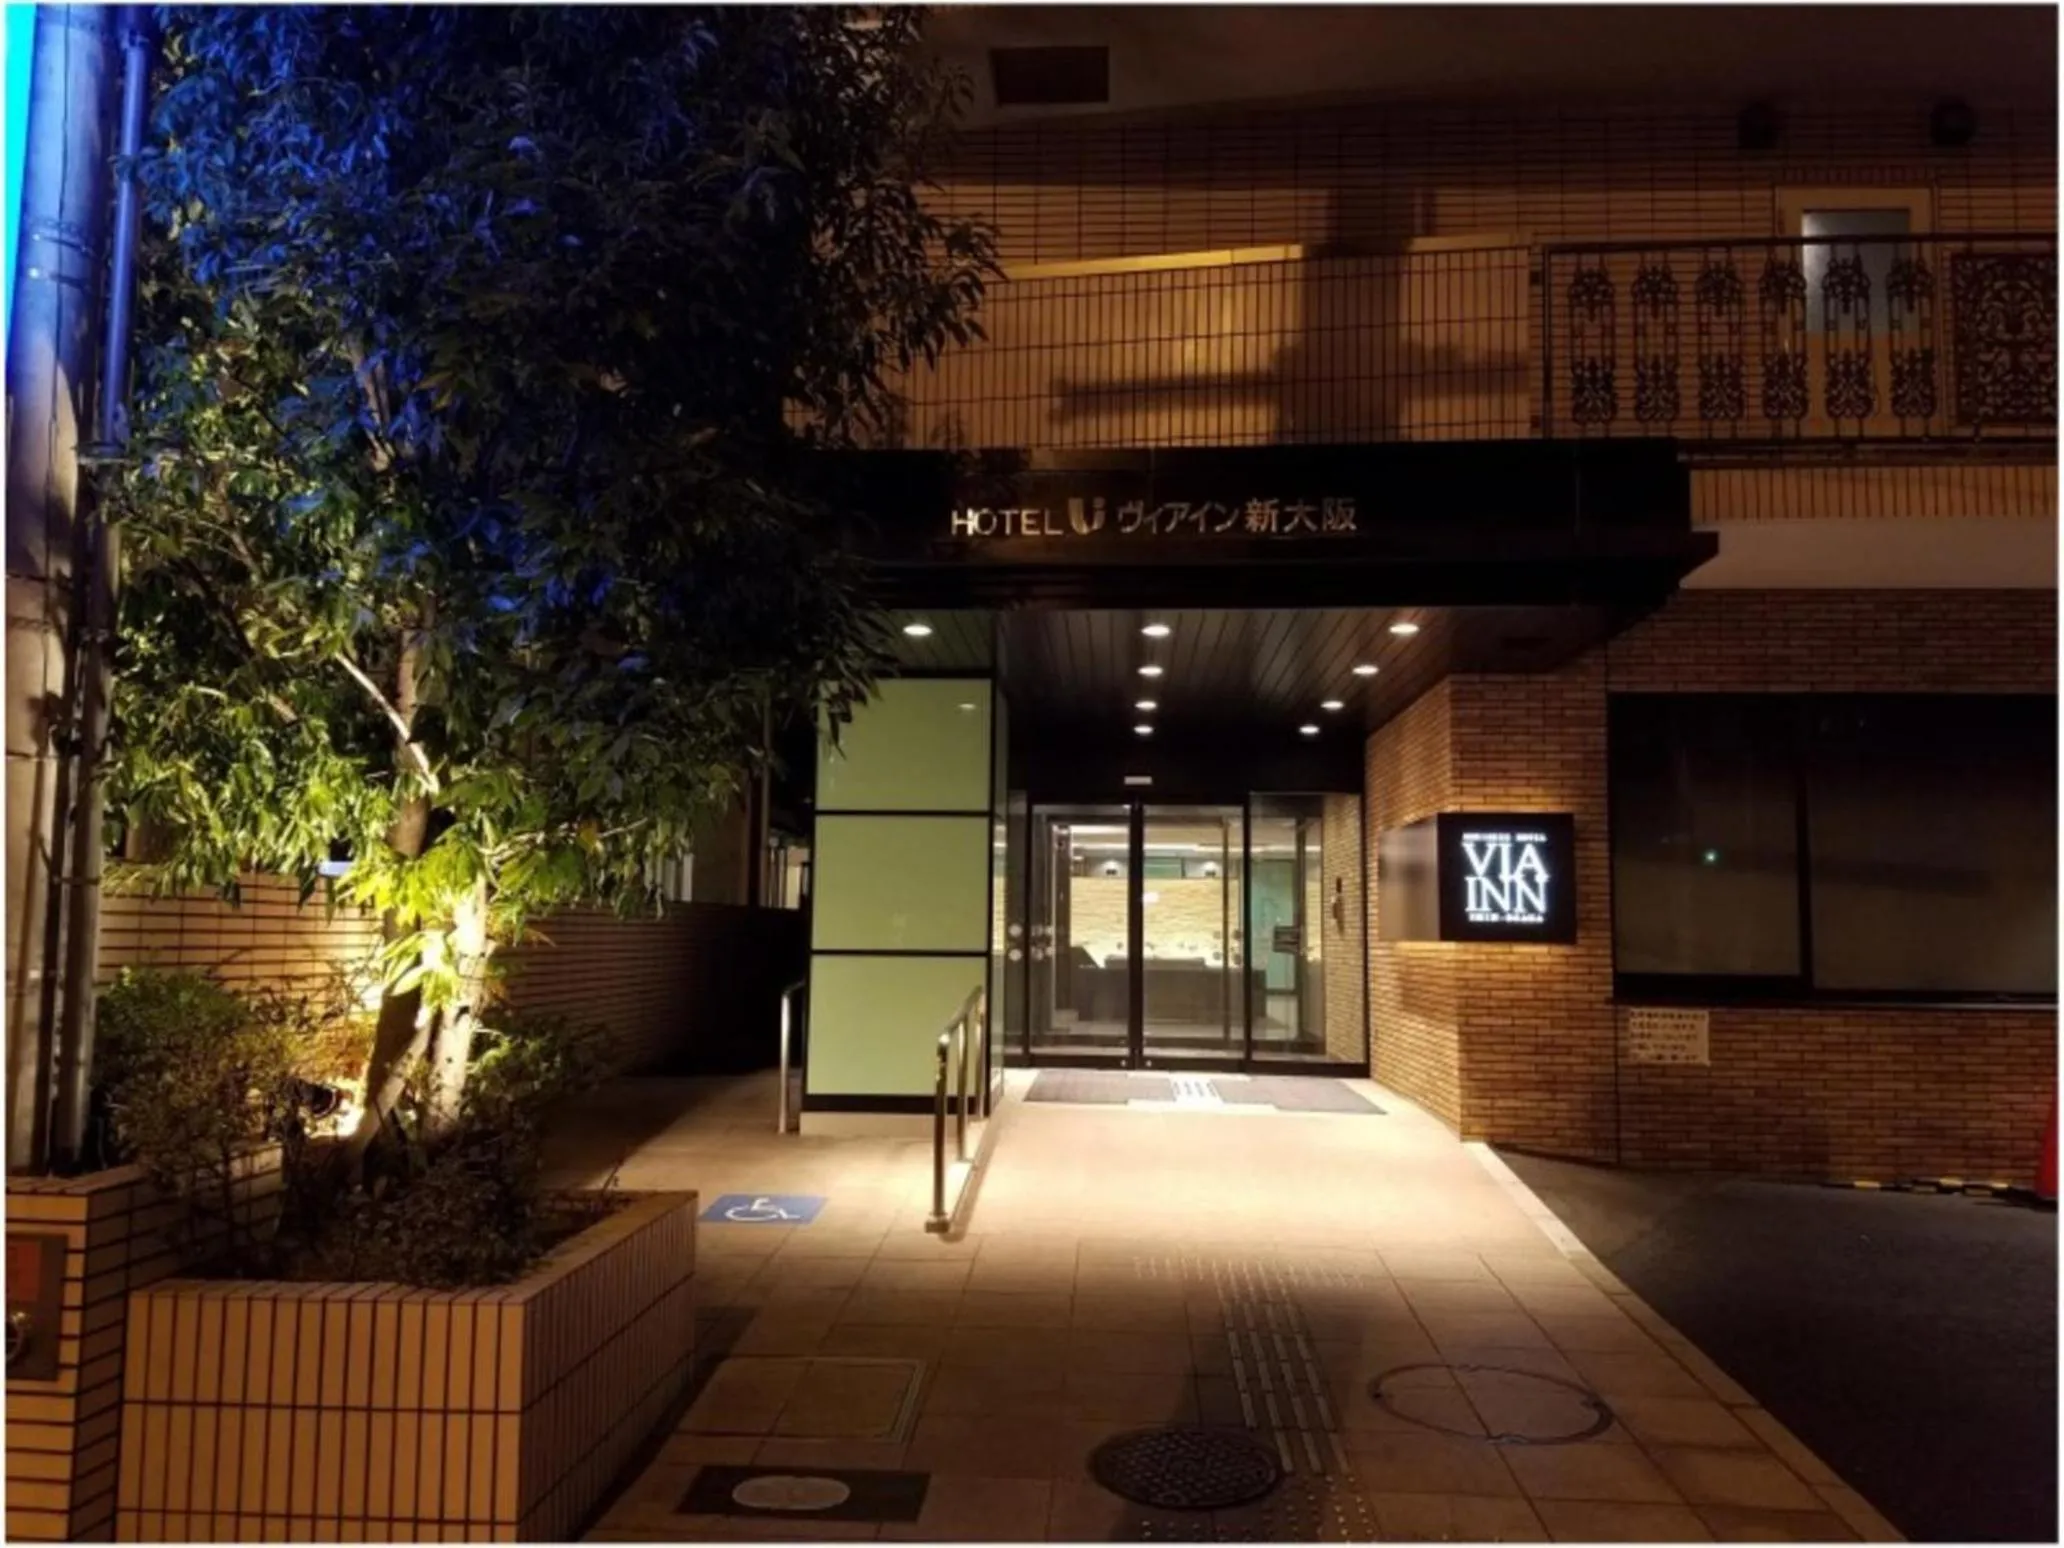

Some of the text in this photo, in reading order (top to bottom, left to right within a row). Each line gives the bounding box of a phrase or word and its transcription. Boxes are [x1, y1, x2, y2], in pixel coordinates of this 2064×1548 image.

[952, 508, 1063, 536] HOTEL
[1117, 498, 1357, 534] ヴィアイン新大阪
[1461, 843, 1549, 881] VIA
[1465, 876, 1547, 913] INN
